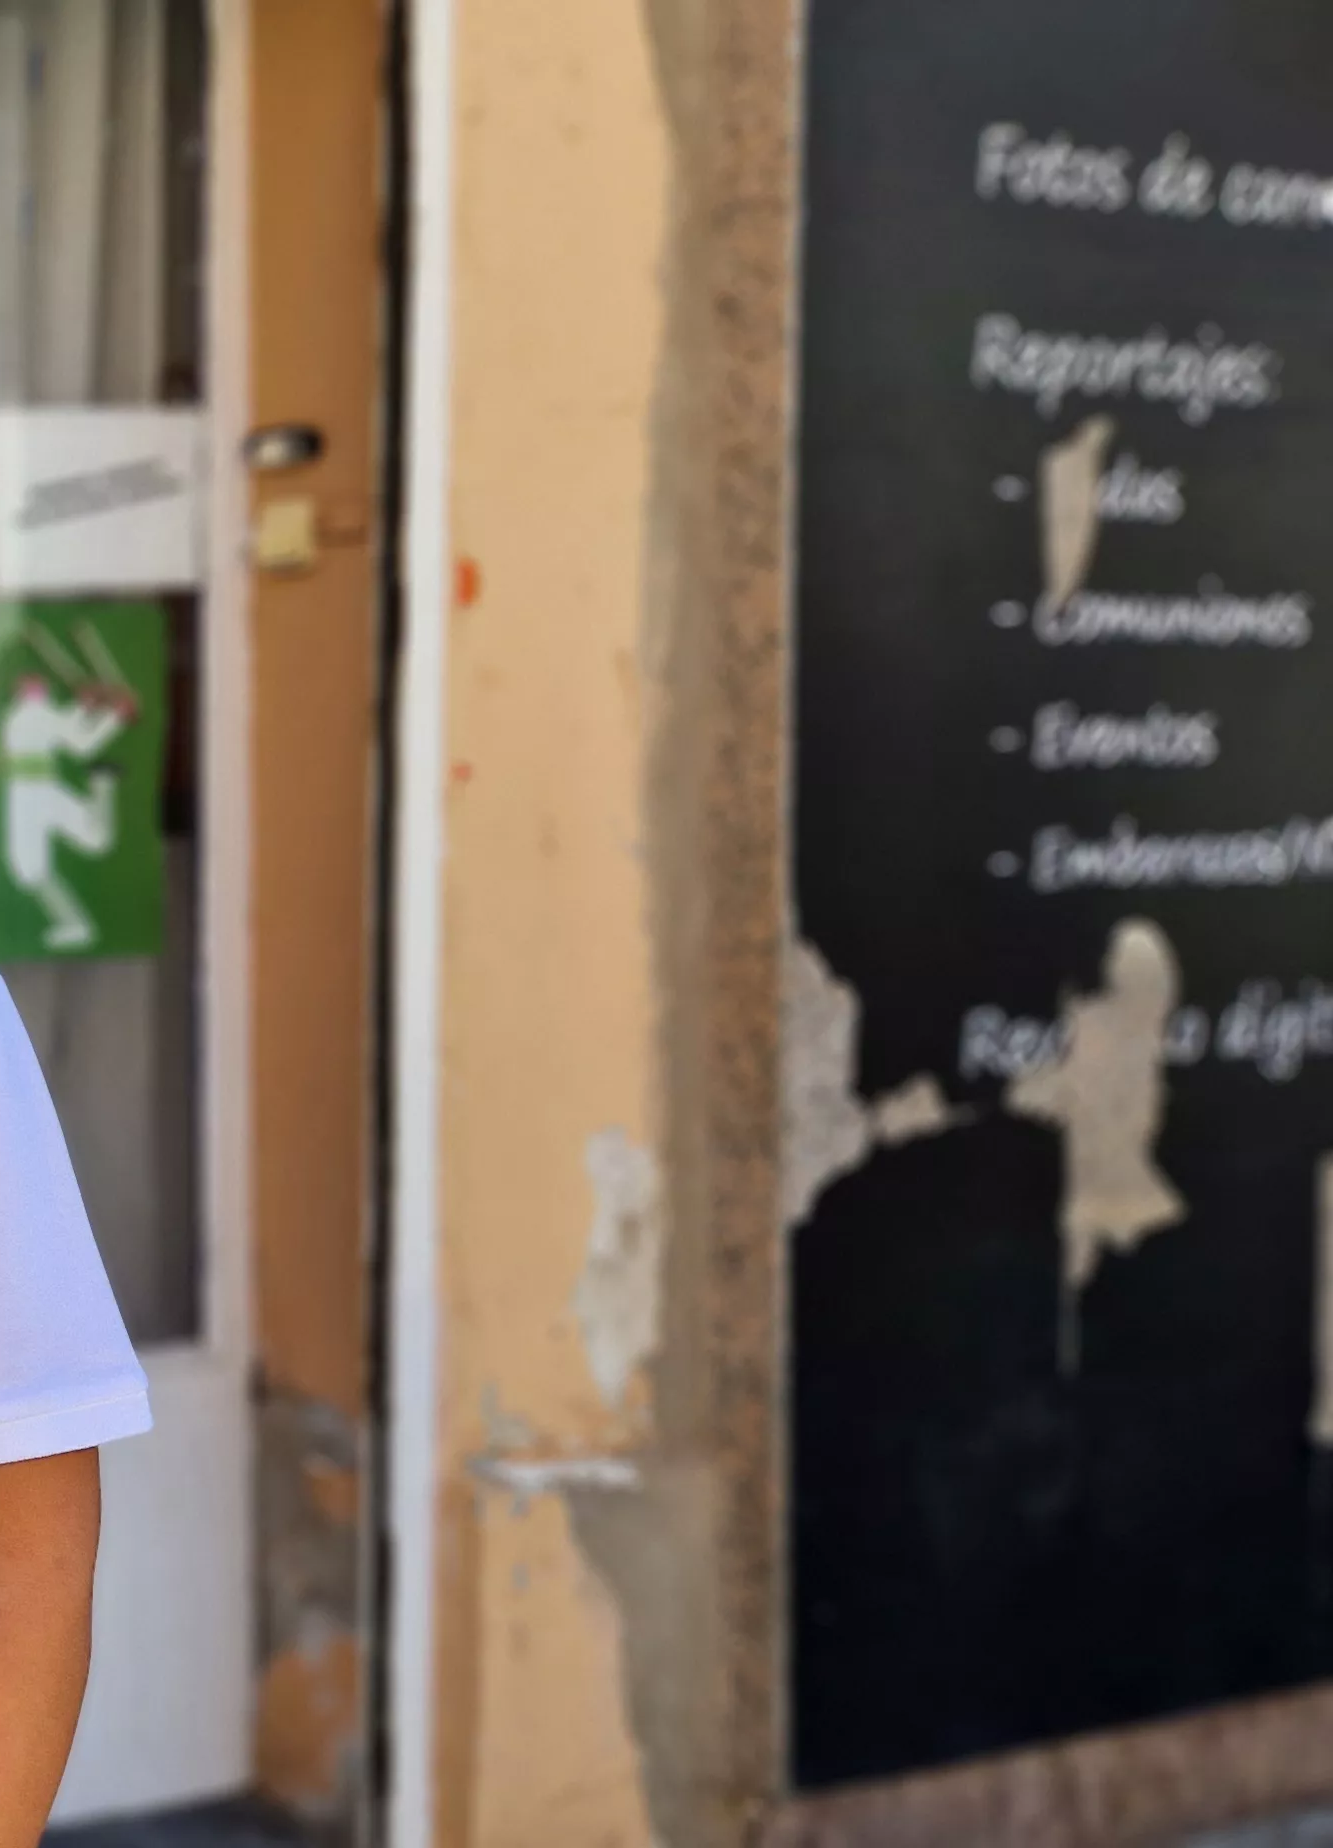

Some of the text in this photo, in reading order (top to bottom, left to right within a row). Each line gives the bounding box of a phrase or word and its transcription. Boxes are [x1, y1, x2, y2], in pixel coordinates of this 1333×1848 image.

[976, 123, 1132, 213] Fotos
[1138, 130, 1215, 220] de
[1033, 575, 1313, 647] Comuniones
[1031, 700, 1219, 772] Eventos
